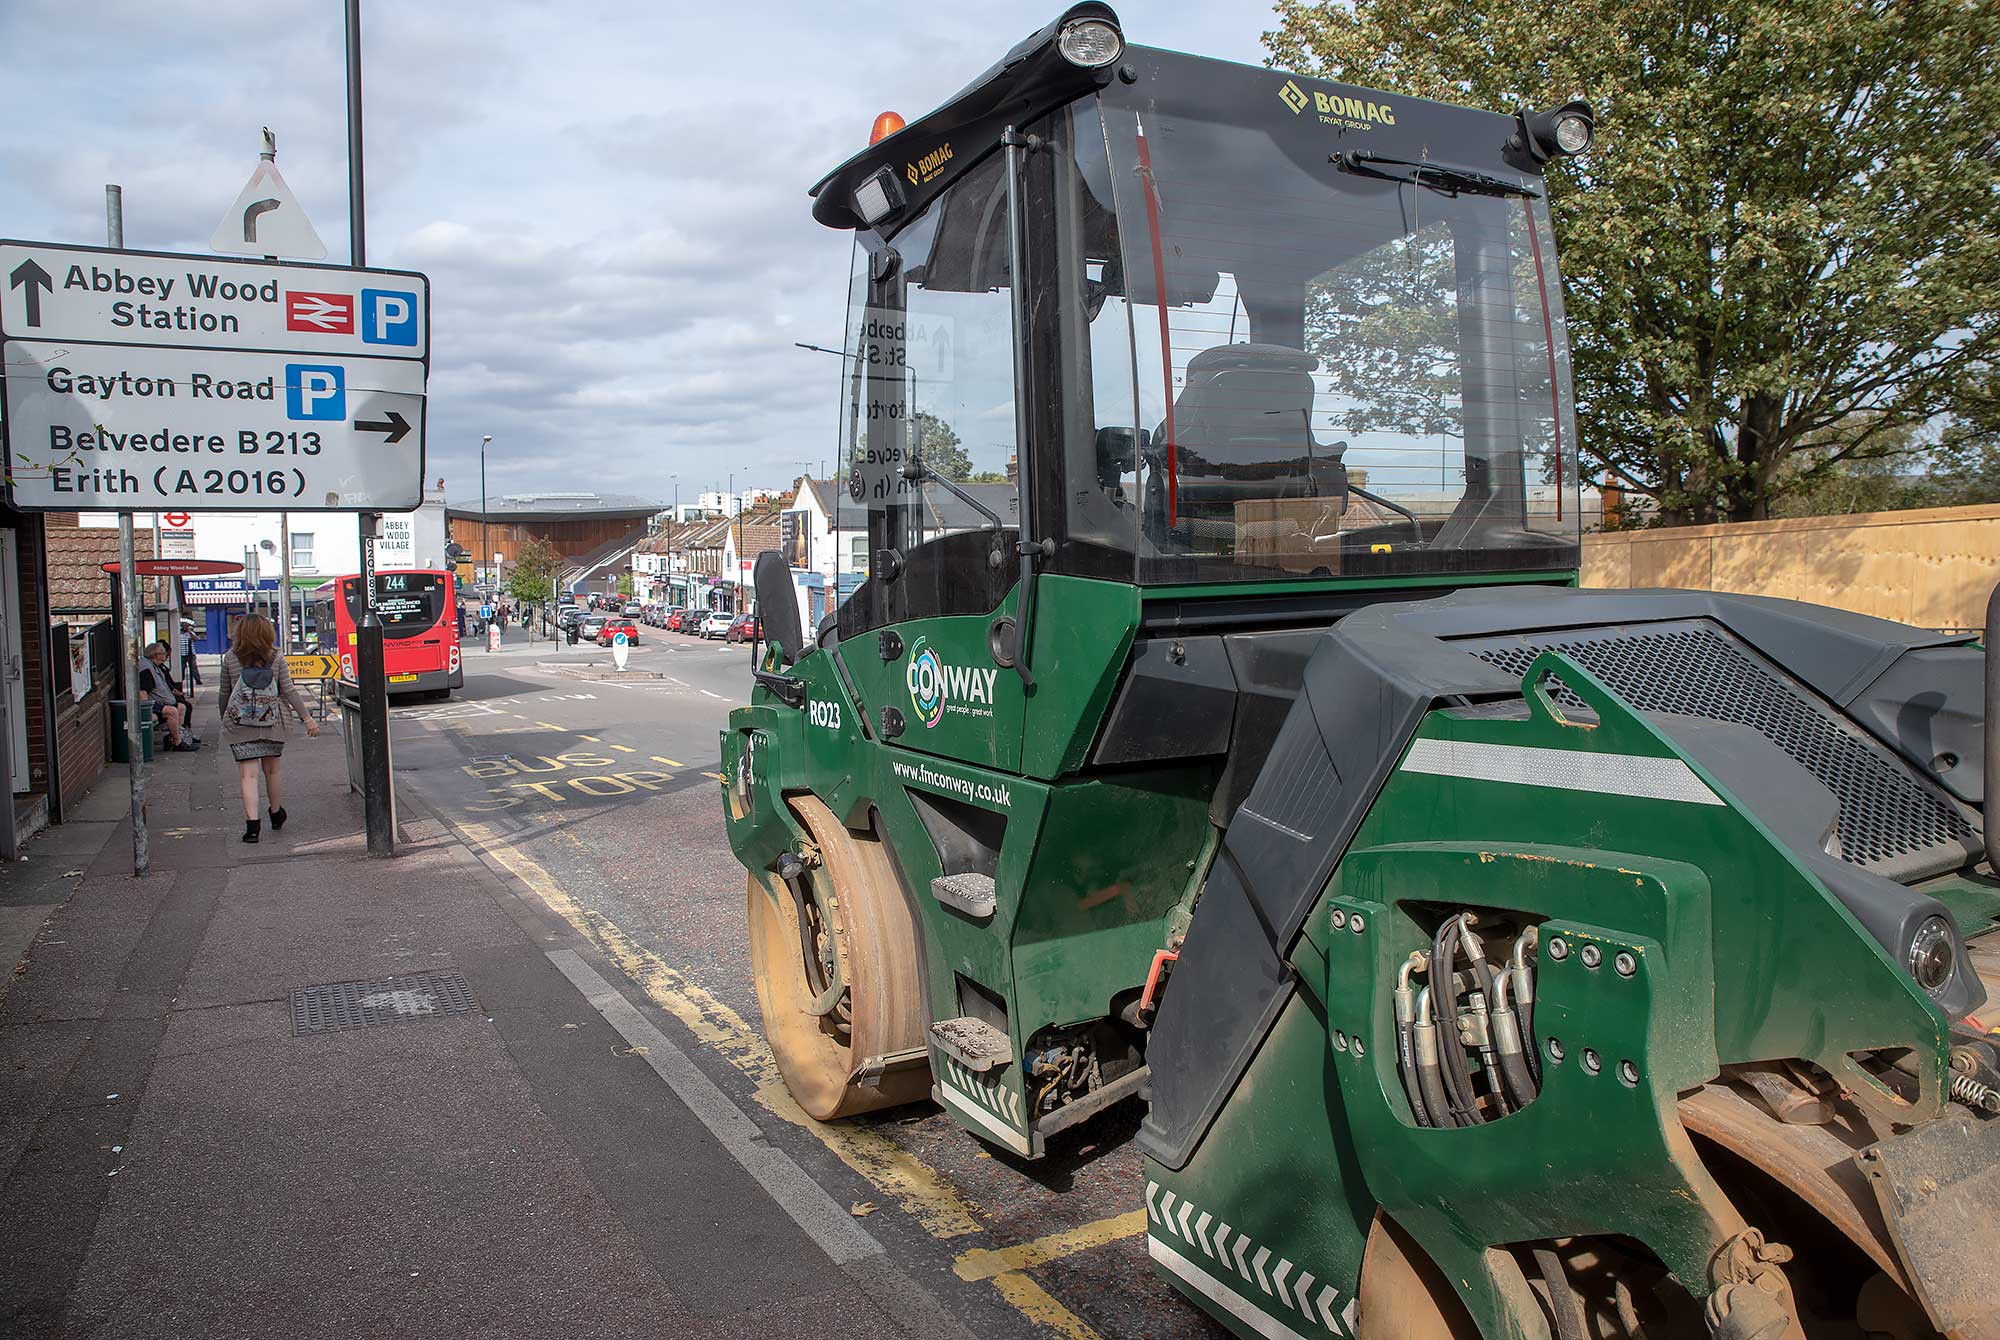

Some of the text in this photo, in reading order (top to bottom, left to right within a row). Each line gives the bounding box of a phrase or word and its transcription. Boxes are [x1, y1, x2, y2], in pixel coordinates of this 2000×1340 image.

[1313, 91, 1395, 125] BOMAG
[1319, 115, 1371, 131] FAYAT GROUP
[917, 142, 953, 176] BOMAG
[63, 265, 278, 303] Abbey Wood
[110, 302, 239, 333] Station
[376, 296, 409, 340] P
[47, 367, 275, 401] Gayton Road
[301, 371, 337, 416] P
[49, 425, 322, 457] Belvedere B213
[53, 466, 306, 498] Erith (A2016)
[385, 521, 409, 530] ABBEY
[386, 531, 410, 540] WOOD
[380, 541, 410, 550] VILLAGE
[188, 581, 242, 590] BILL'S BARBER
[385, 576, 405, 590] 244
[906, 659, 998, 705] CONWAY
[809, 700, 841, 729] RO23
[946, 704, 956, 713] great
[957, 704, 969, 715] people
[972, 708, 982, 717] great
[983, 708, 993, 717] work
[462, 752, 616, 779] BUS
[892, 761, 1012, 808] www.fmconway.co.uk
